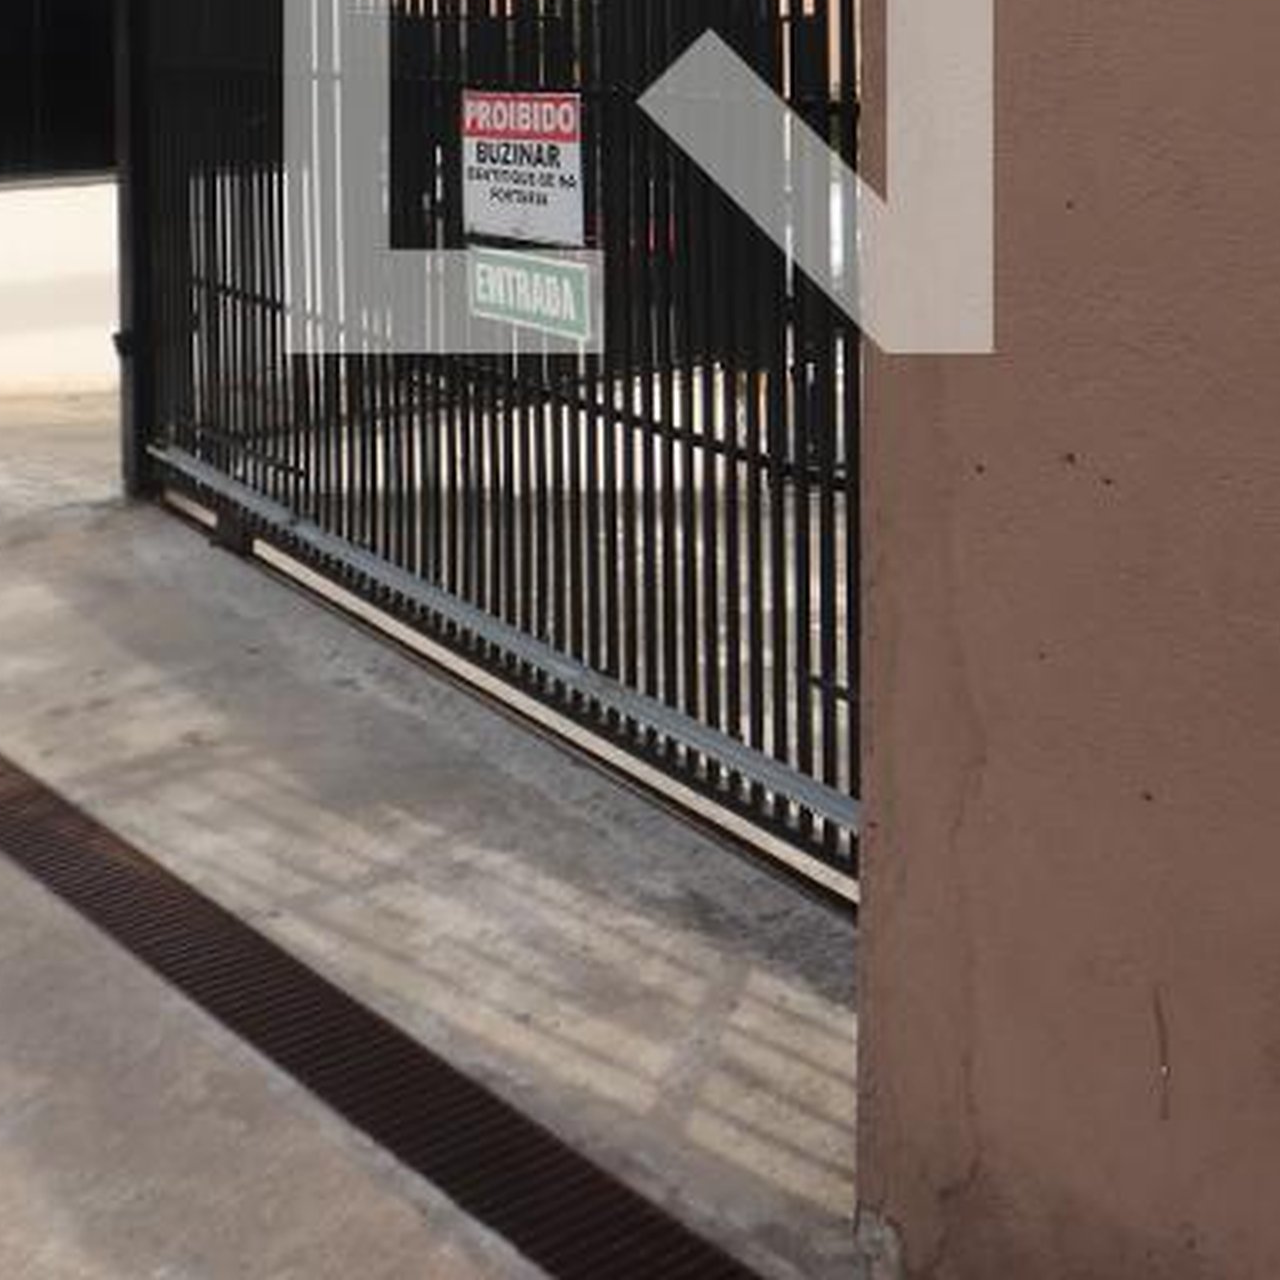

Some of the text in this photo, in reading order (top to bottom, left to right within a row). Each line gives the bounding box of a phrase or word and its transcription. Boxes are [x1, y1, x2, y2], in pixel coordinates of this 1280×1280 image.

[464, 98, 576, 134] PROIBIDO
[476, 142, 561, 169] BUZINAR
[476, 262, 577, 321] ENTRADA
